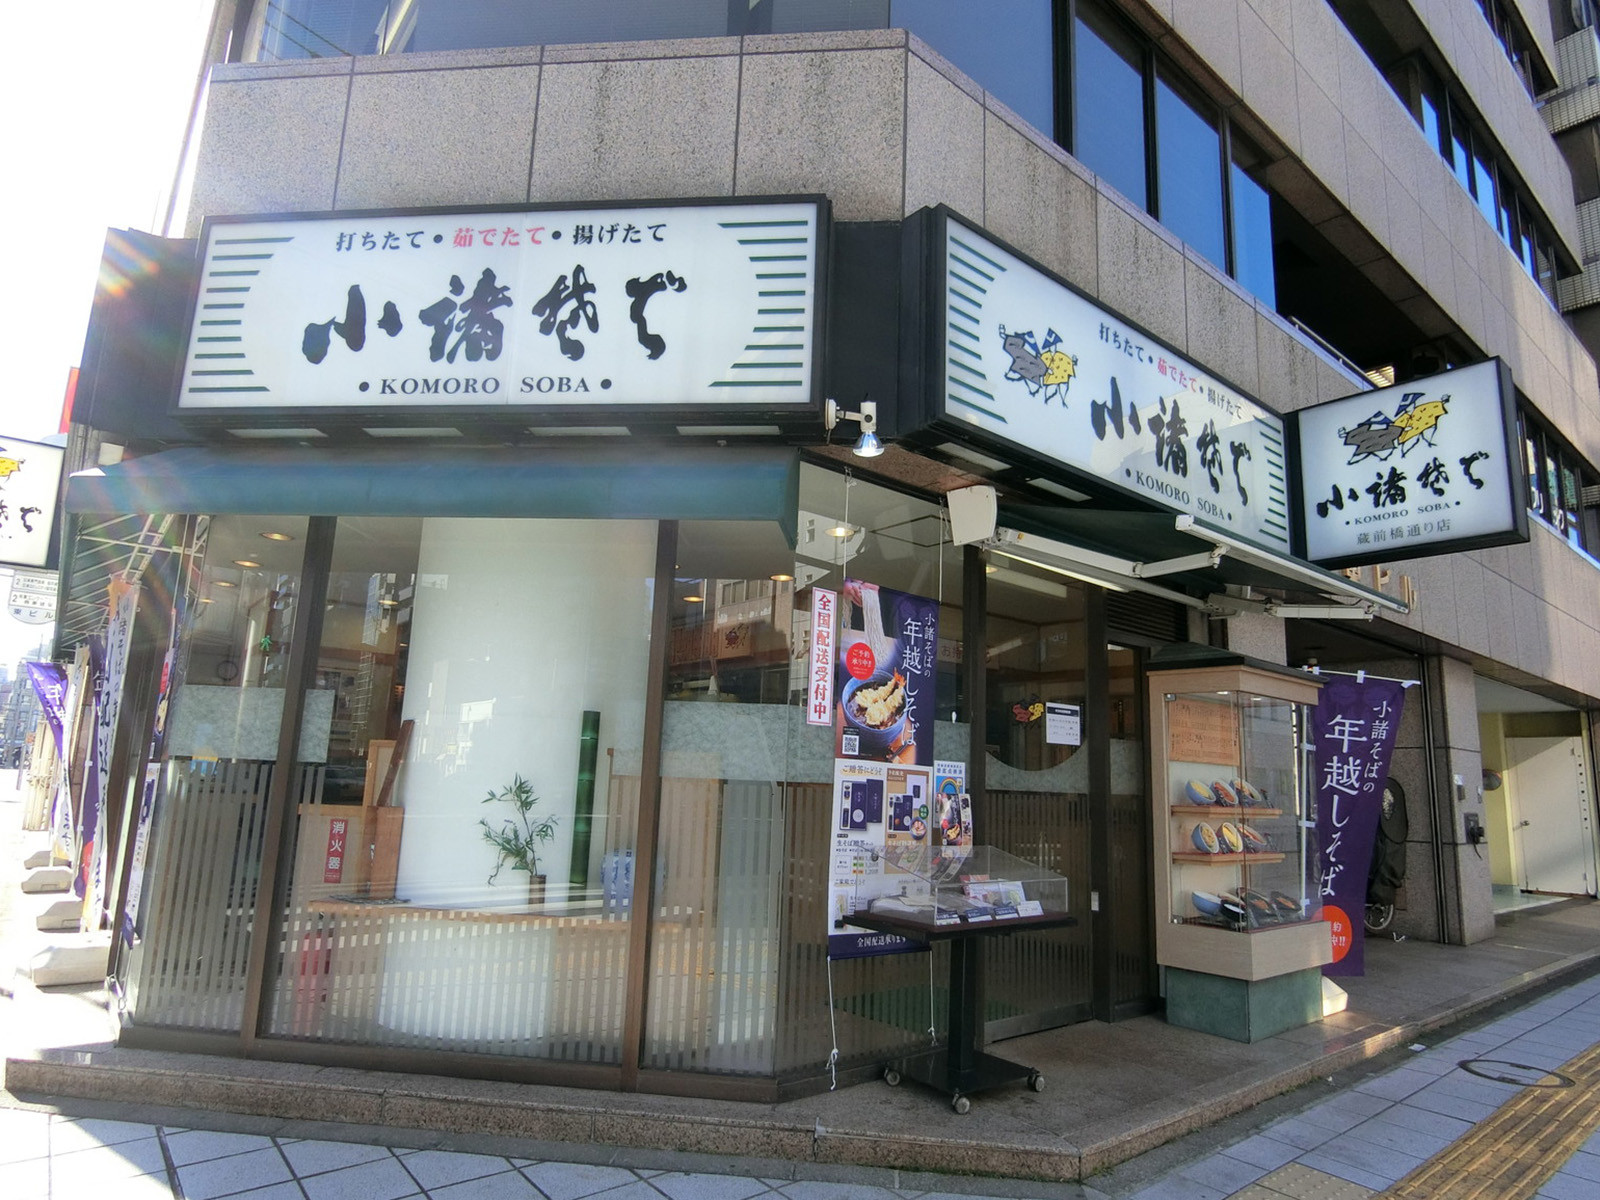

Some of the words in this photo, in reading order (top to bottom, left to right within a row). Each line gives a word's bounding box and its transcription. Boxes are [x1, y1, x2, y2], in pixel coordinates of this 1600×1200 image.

[379, 377, 500, 396] KOMORO
[519, 376, 591, 394] SOBA
[1135, 469, 1191, 505] KOMORO
[1197, 497, 1225, 521] SOBA
[1354, 509, 1409, 525] KOMORO
[1417, 502, 1451, 515] SOBA
[1356, 518, 1451, 545] 蔵前橋通り店
[814, 594, 832, 720] 全国配送受付中
[923, 613, 936, 678] 小諸そばの
[902, 617, 922, 746] 年越しそば
[1362, 700, 1392, 793] 小諸そばの
[1317, 714, 1368, 898] 年越しそば
[326, 821, 345, 870] 消火器
